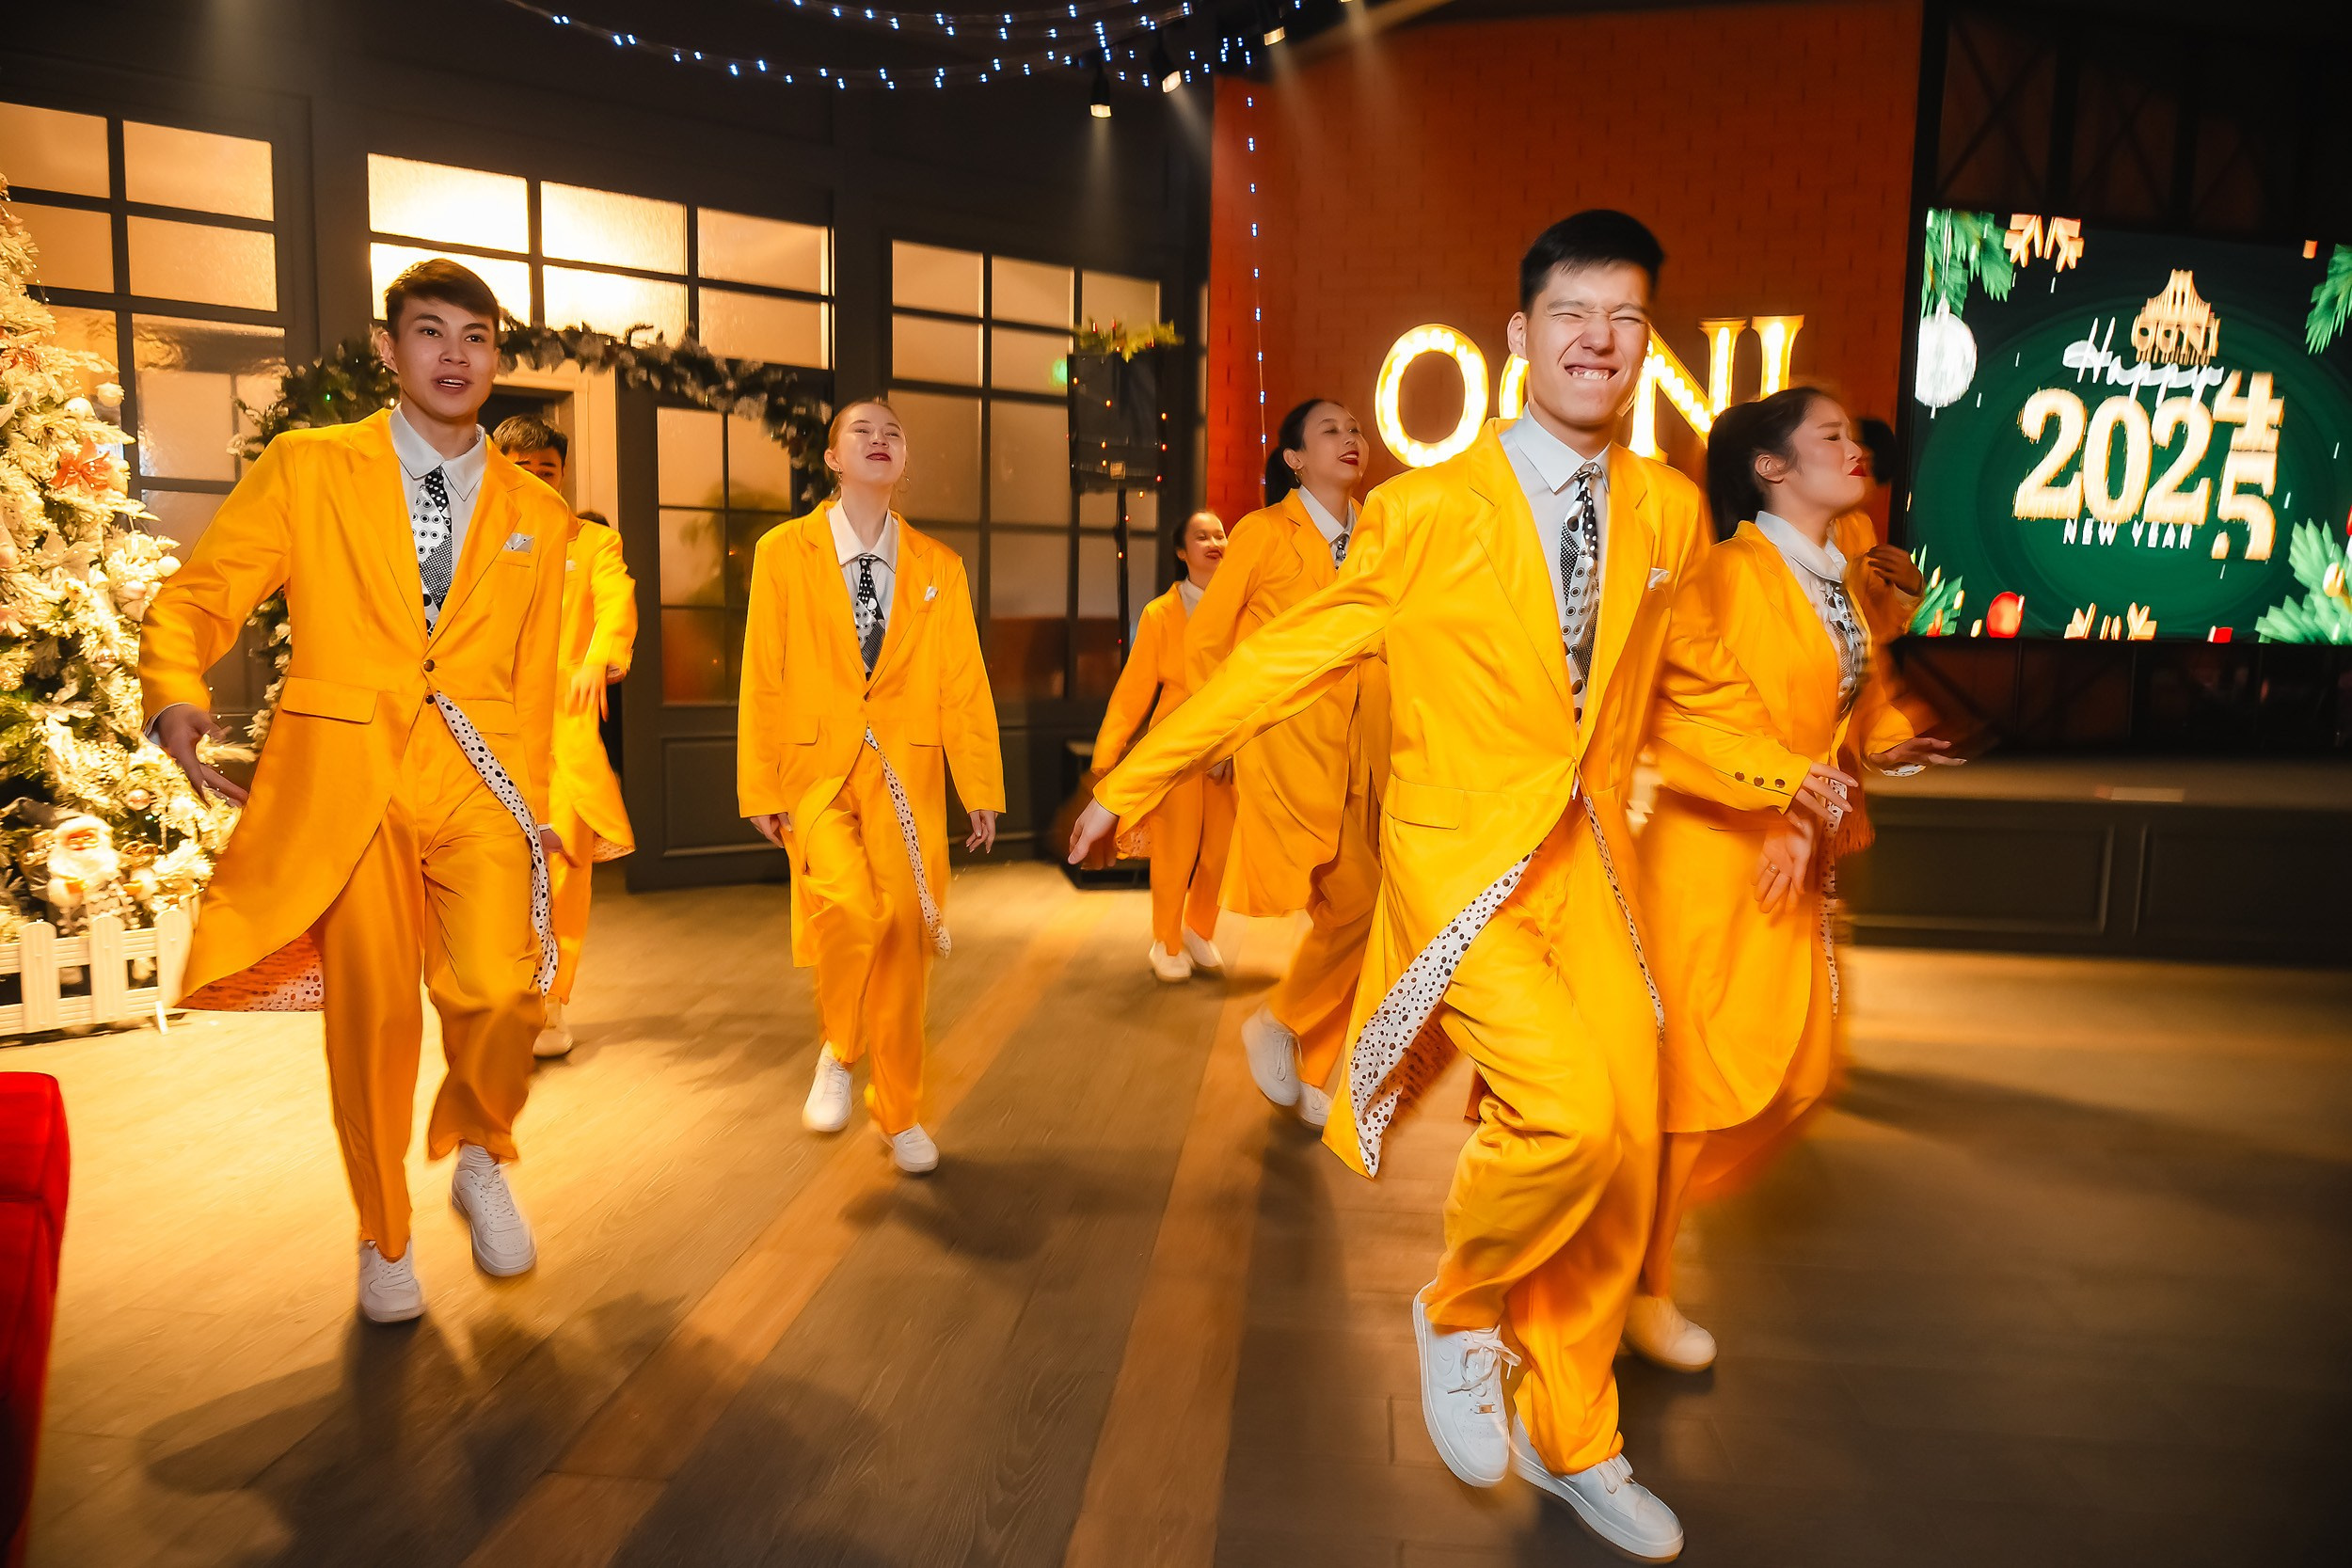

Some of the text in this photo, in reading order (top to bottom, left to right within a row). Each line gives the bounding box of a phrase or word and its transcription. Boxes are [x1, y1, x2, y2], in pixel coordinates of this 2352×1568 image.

[1375, 313, 1804, 467] ONI
[2062, 317, 2224, 408] Happy
[2063, 517, 2193, 549] NEW YEAR
